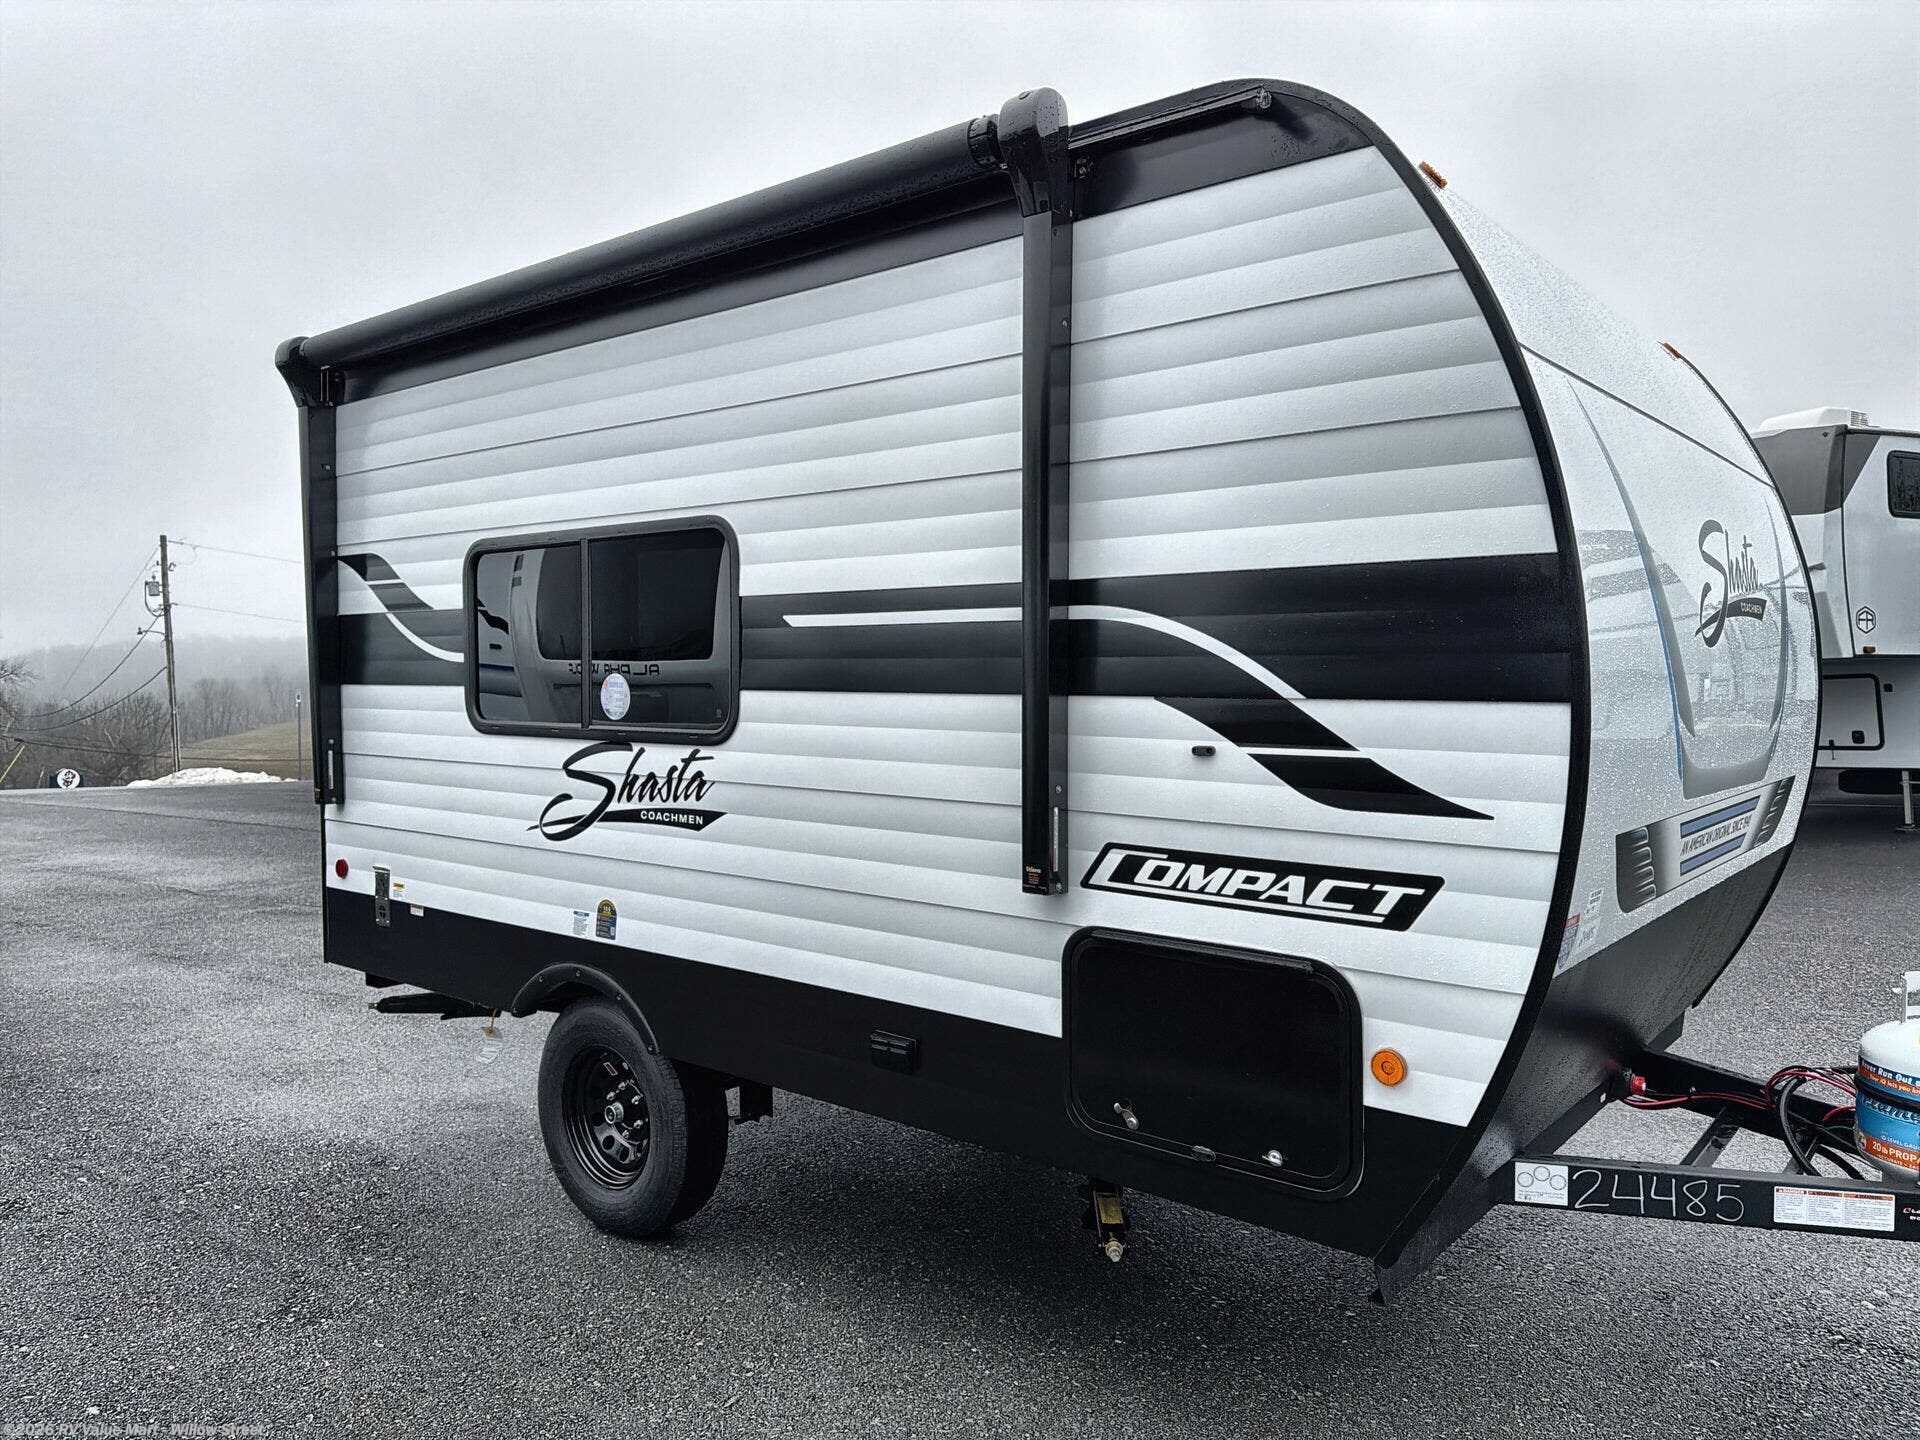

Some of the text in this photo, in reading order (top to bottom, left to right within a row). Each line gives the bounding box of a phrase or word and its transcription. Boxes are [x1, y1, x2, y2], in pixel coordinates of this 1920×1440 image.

[1698, 519, 1759, 648] Shasta
[539, 741, 715, 841] Shasta
[640, 810, 704, 825] COACHMEN
[1088, 847, 1425, 921] COMPACT
[1889, 1147, 1920, 1164] PROP
[1572, 1169, 1744, 1222] 24485
